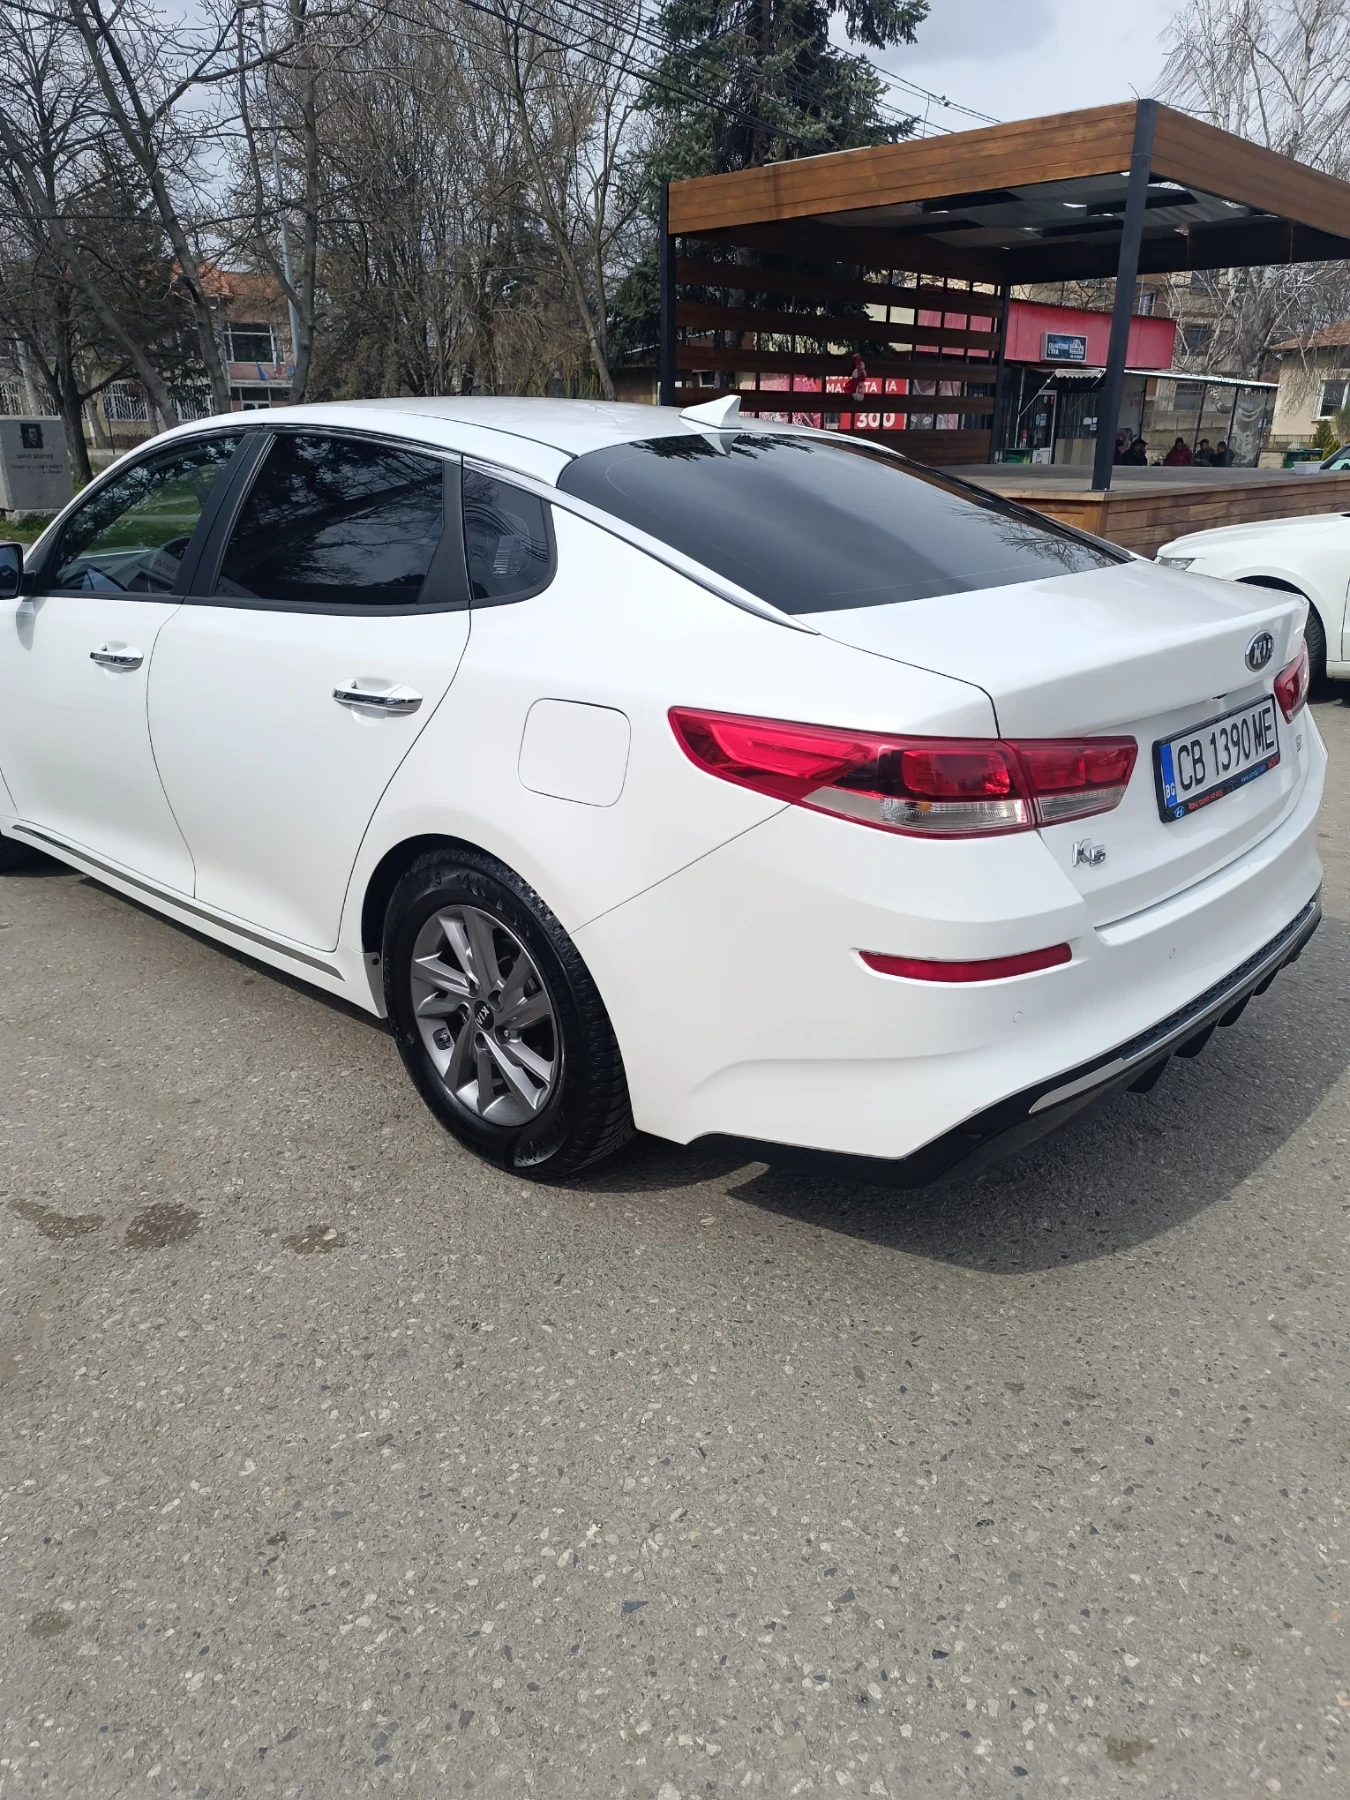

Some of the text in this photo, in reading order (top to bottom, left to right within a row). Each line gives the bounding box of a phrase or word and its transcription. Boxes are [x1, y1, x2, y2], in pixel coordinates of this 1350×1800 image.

[826, 382, 878, 393] МАТА
[856, 413, 896, 427] 300
[1253, 639, 1272, 665] KIA
[1177, 706, 1275, 791] CB 1390 ME
[1166, 783, 1176, 798] BG
[1072, 838, 1106, 867] K5
[476, 1005, 490, 1025] KIA
